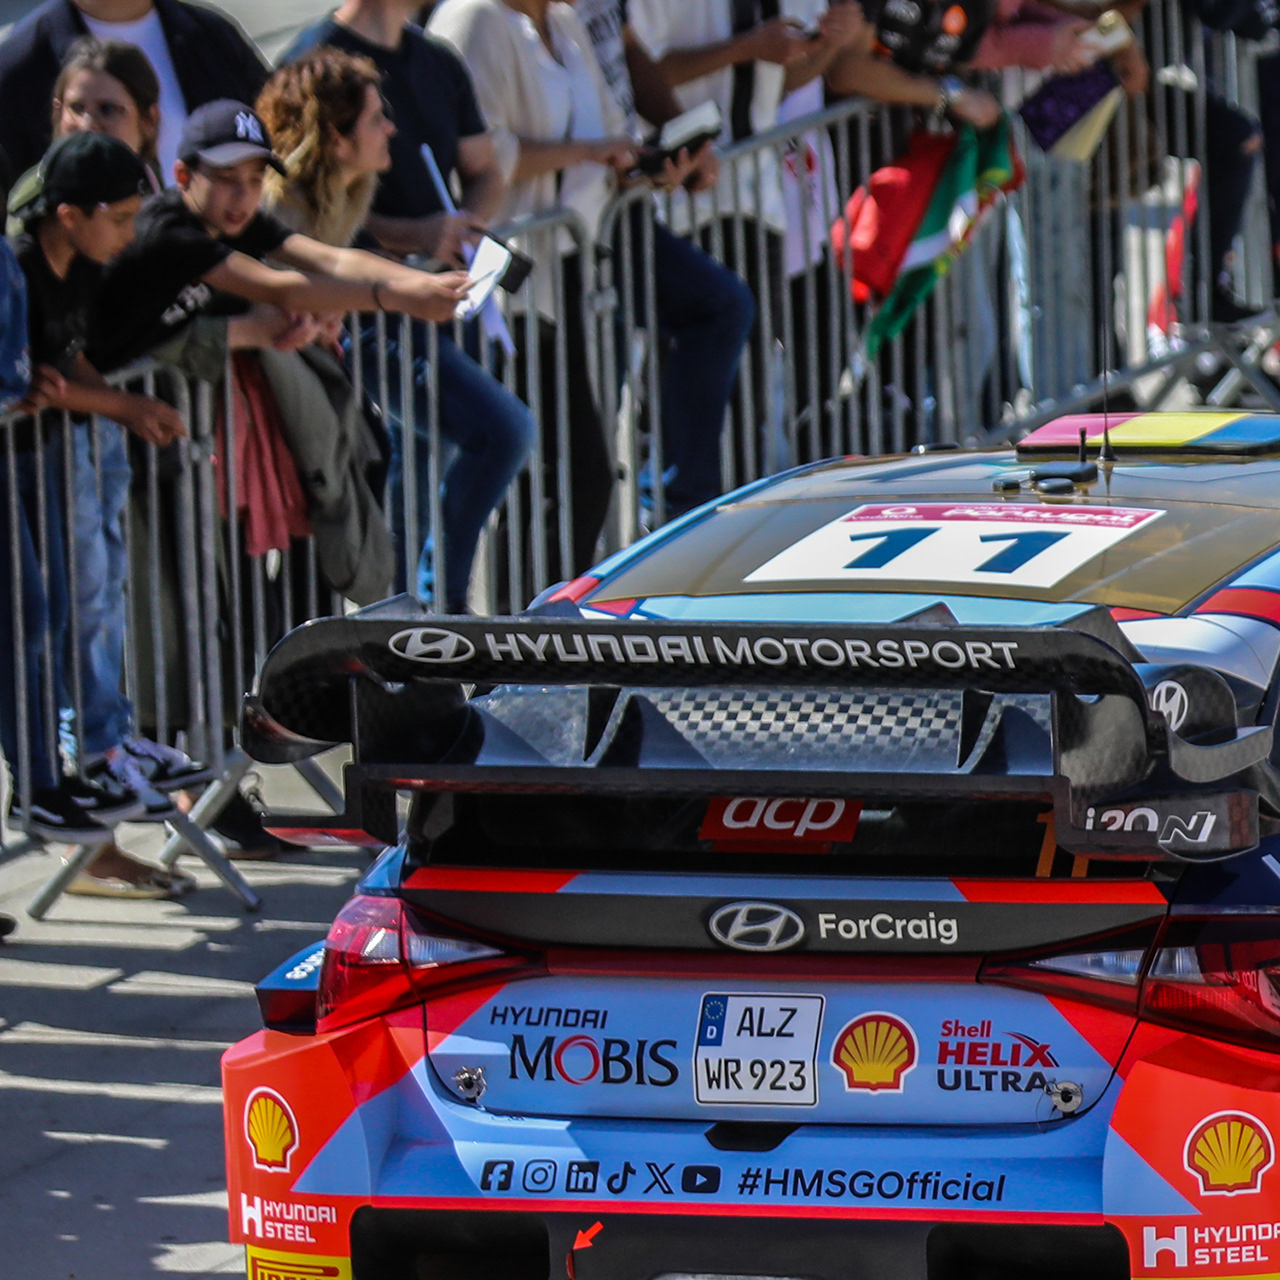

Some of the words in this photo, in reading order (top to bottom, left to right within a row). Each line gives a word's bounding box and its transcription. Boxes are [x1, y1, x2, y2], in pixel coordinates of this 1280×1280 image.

[842, 527, 1073, 573] 11
[486, 632, 709, 663] HYUNDAI
[715, 636, 1019, 670] MOTORSPORT
[721, 798, 847, 837] acp
[818, 911, 959, 945] ForCraig
[490, 1005, 609, 1030] HYUNDAI
[736, 1008, 796, 1039] ALZ
[940, 1019, 992, 1038] Shell
[509, 1033, 679, 1087] MOBIS
[937, 1035, 1057, 1068] HELIX
[704, 1057, 743, 1090] WR
[749, 1058, 807, 1091] 923
[937, 1069, 1048, 1093] ULTRA
[737, 1166, 1006, 1203] #HMSGOfficial
[263, 1199, 338, 1224] HYUNDAI
[265, 1221, 317, 1244] STEEL
[1194, 1243, 1270, 1266] STEEL
